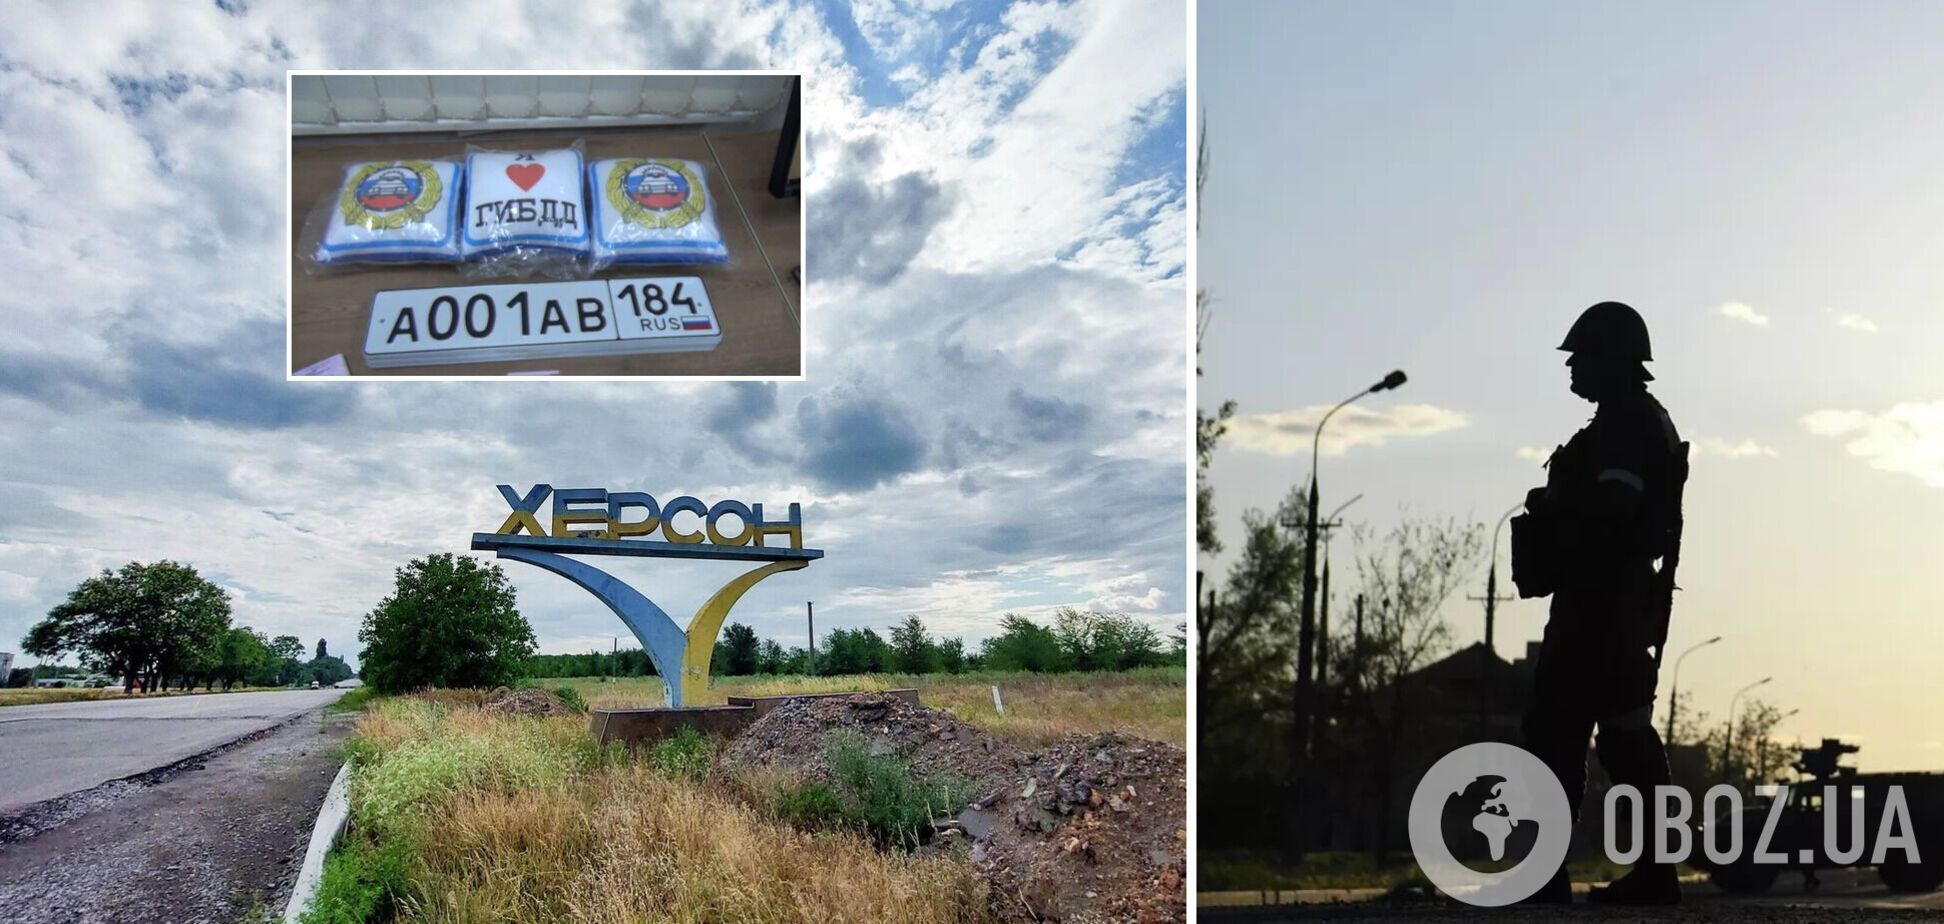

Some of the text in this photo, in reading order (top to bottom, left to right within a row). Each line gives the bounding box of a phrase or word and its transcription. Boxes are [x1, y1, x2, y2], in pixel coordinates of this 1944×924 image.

[475, 197, 578, 229] ГИБДД
[617, 281, 698, 317] 184
[641, 317, 682, 332] RUS
[495, 483, 804, 550] ХЕРСОН
